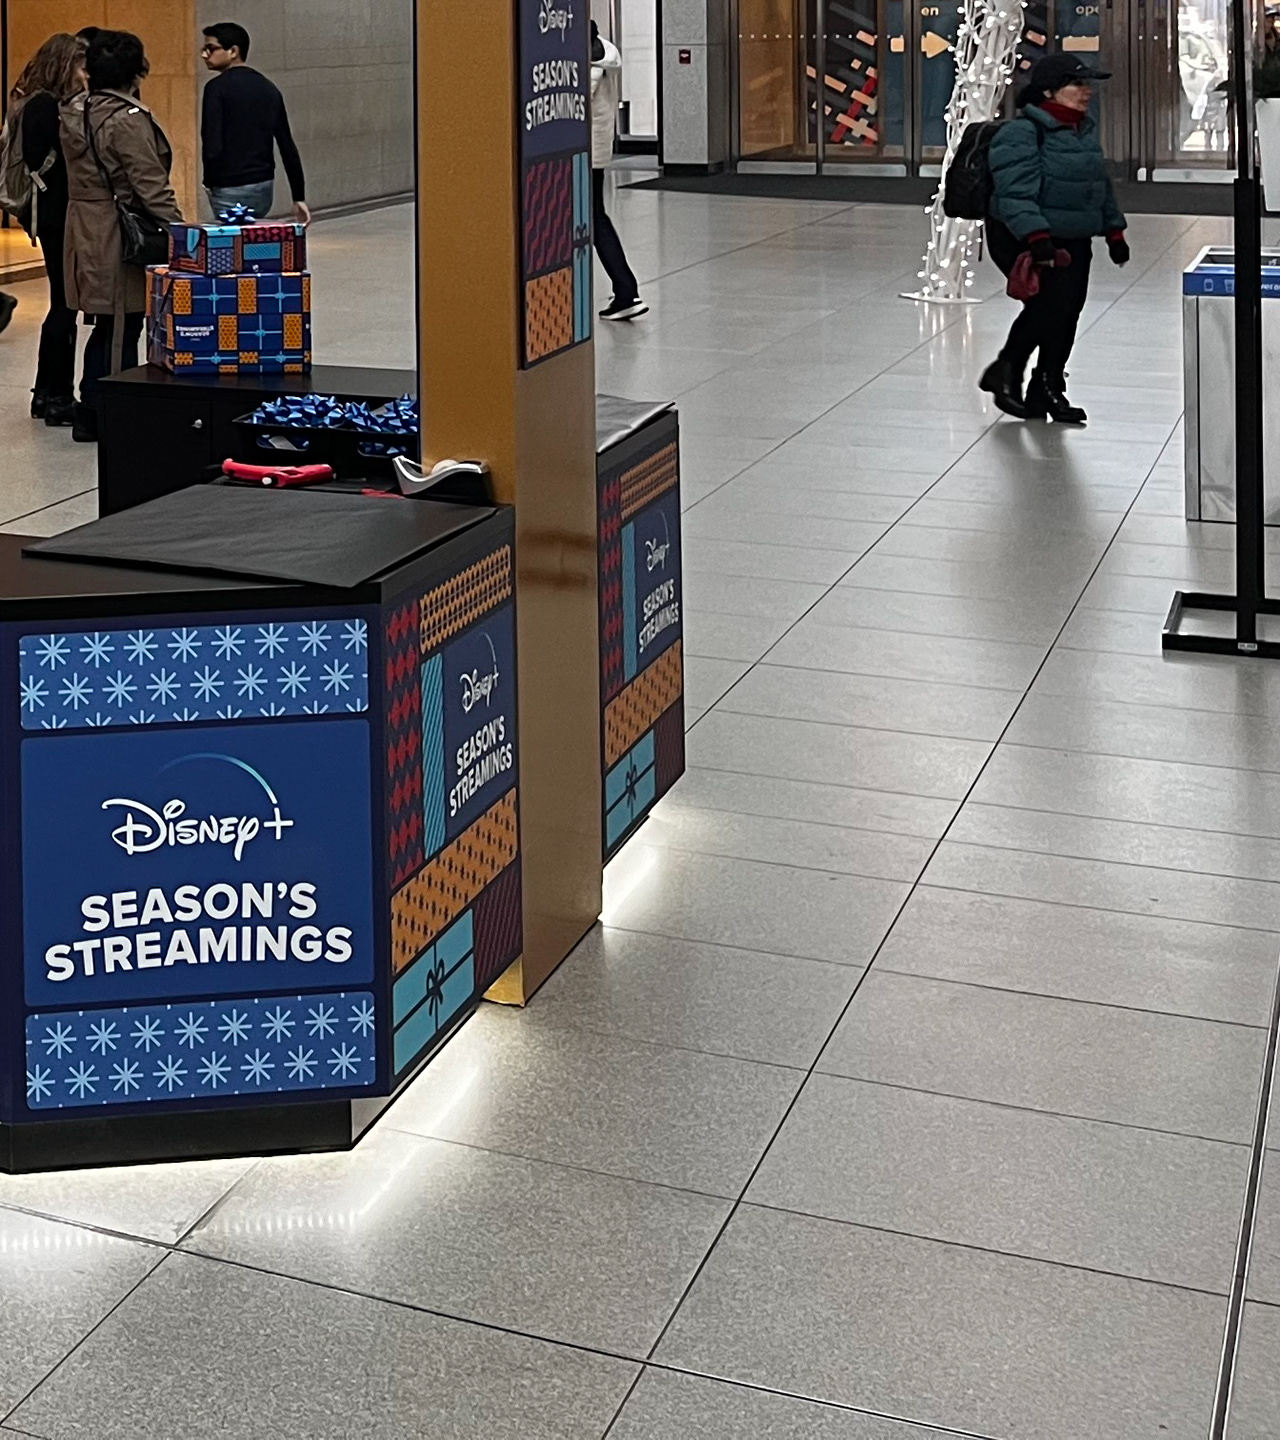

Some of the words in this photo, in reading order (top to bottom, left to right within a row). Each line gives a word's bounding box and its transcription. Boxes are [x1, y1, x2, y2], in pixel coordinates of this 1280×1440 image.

[532, 60, 579, 93] SEASON'S
[525, 92, 585, 131] STREAMINGS
[460, 669, 499, 713] Disney+
[456, 715, 505, 776] SEASON'S
[449, 743, 512, 817] STREAMINGS
[101, 797, 294, 861] Disney+
[81, 882, 317, 932] SEASON'S
[45, 926, 354, 982] STREAMINGS
